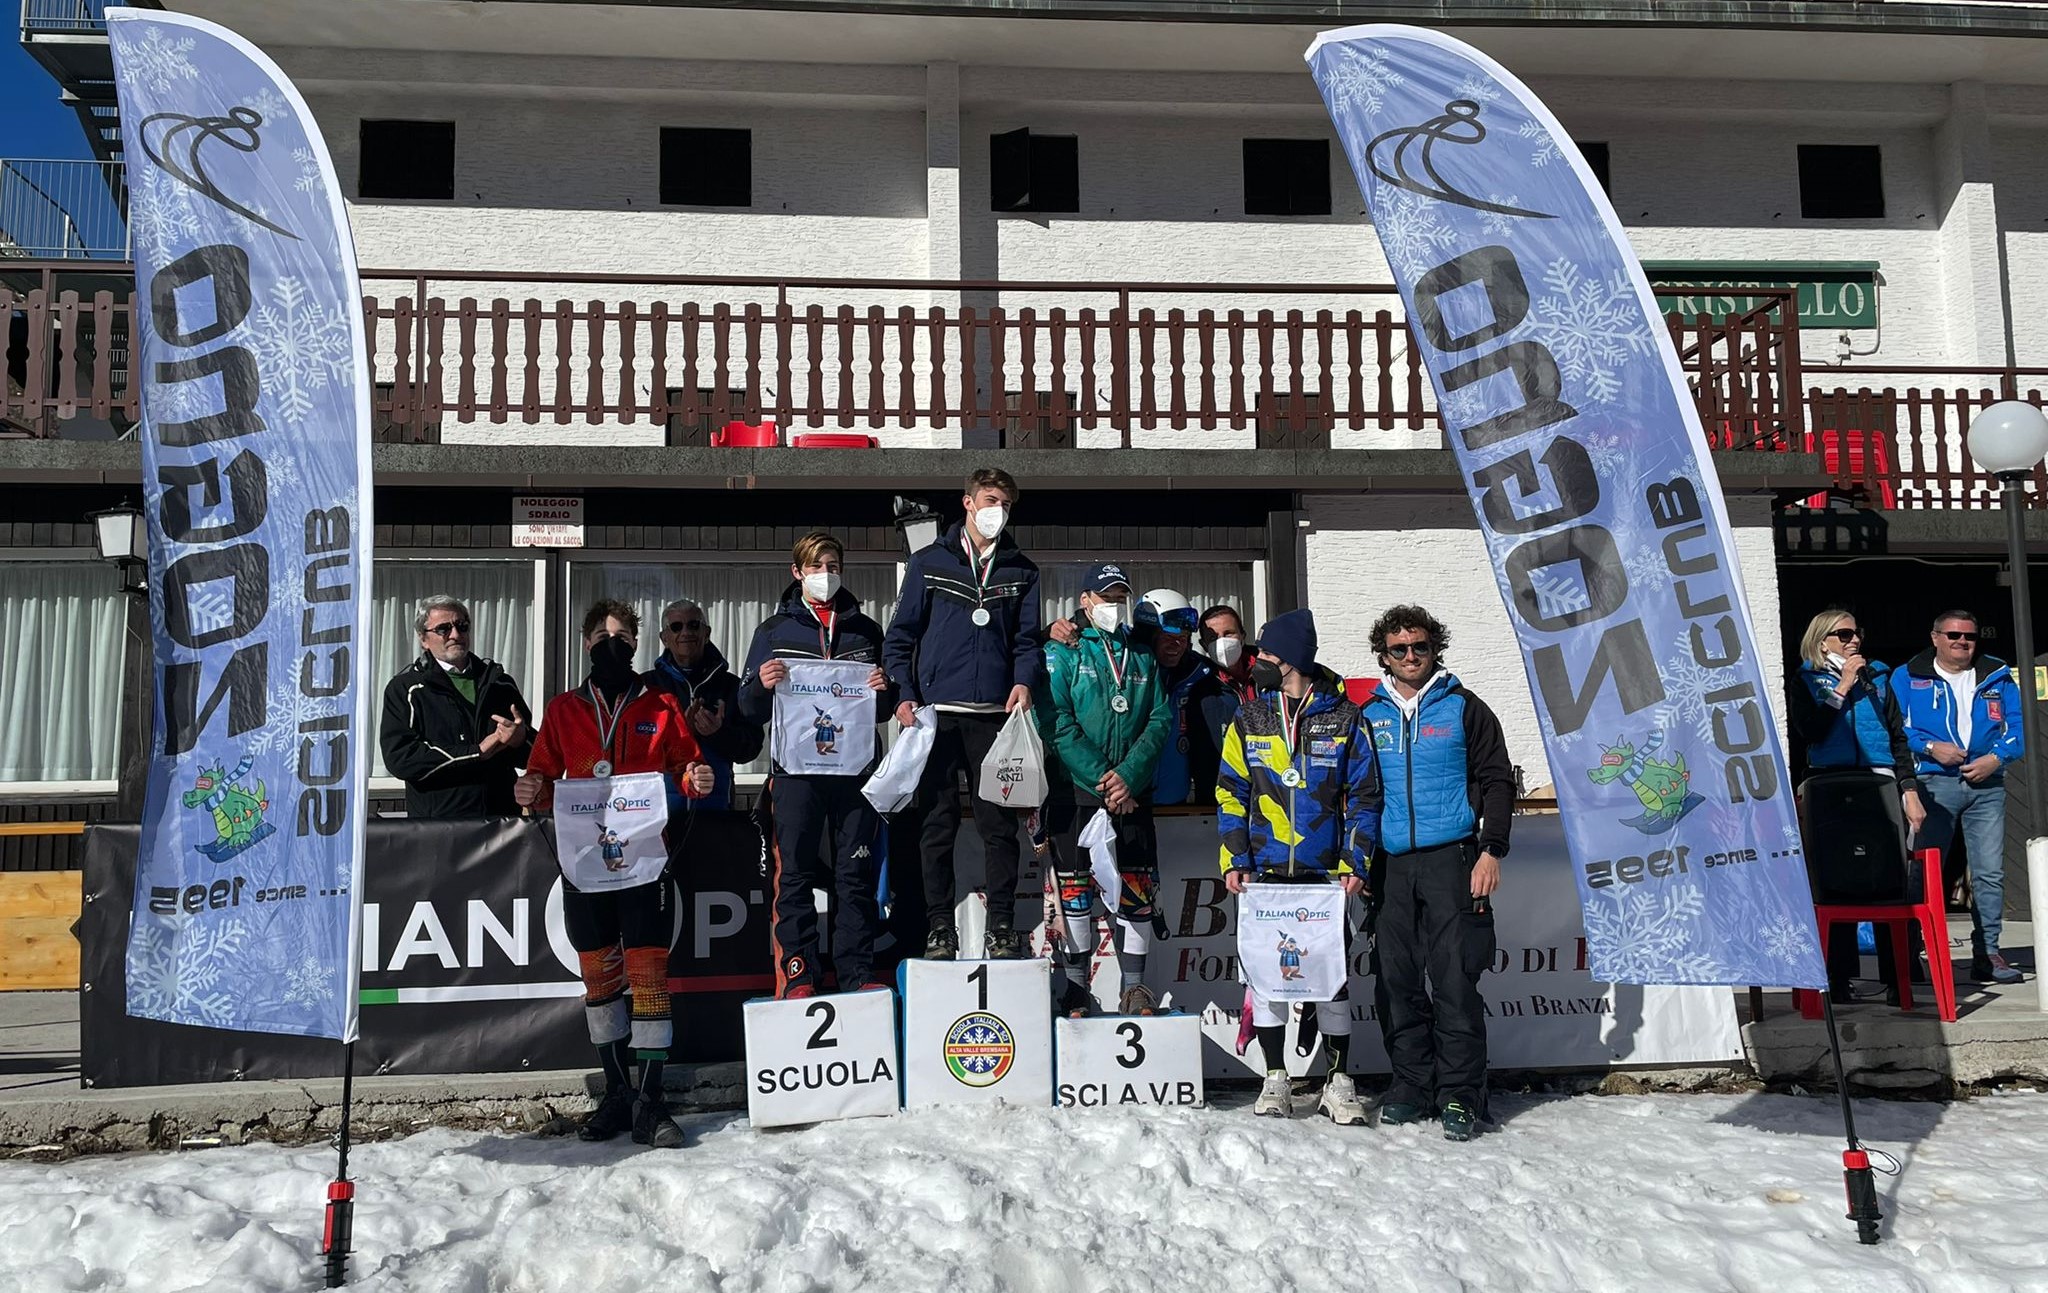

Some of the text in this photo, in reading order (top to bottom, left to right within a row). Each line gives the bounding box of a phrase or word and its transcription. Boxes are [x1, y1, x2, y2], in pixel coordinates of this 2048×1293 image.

[520, 499, 579, 507] NOLEGGIO
[528, 510, 570, 519] SDRAIO
[1521, 946, 1558, 973] DI
[967, 964, 988, 1010] 1
[1500, 1001, 1526, 1018] DI
[1531, 994, 1614, 1016] BRANZI
[805, 1001, 838, 1050] 2
[951, 1017, 1009, 1042] SCUOLA ITALIANA SCI
[1115, 1021, 1146, 1069] 3
[756, 1057, 893, 1095] SCUOLA
[1058, 1081, 1203, 1107] SCI A.V.B.
